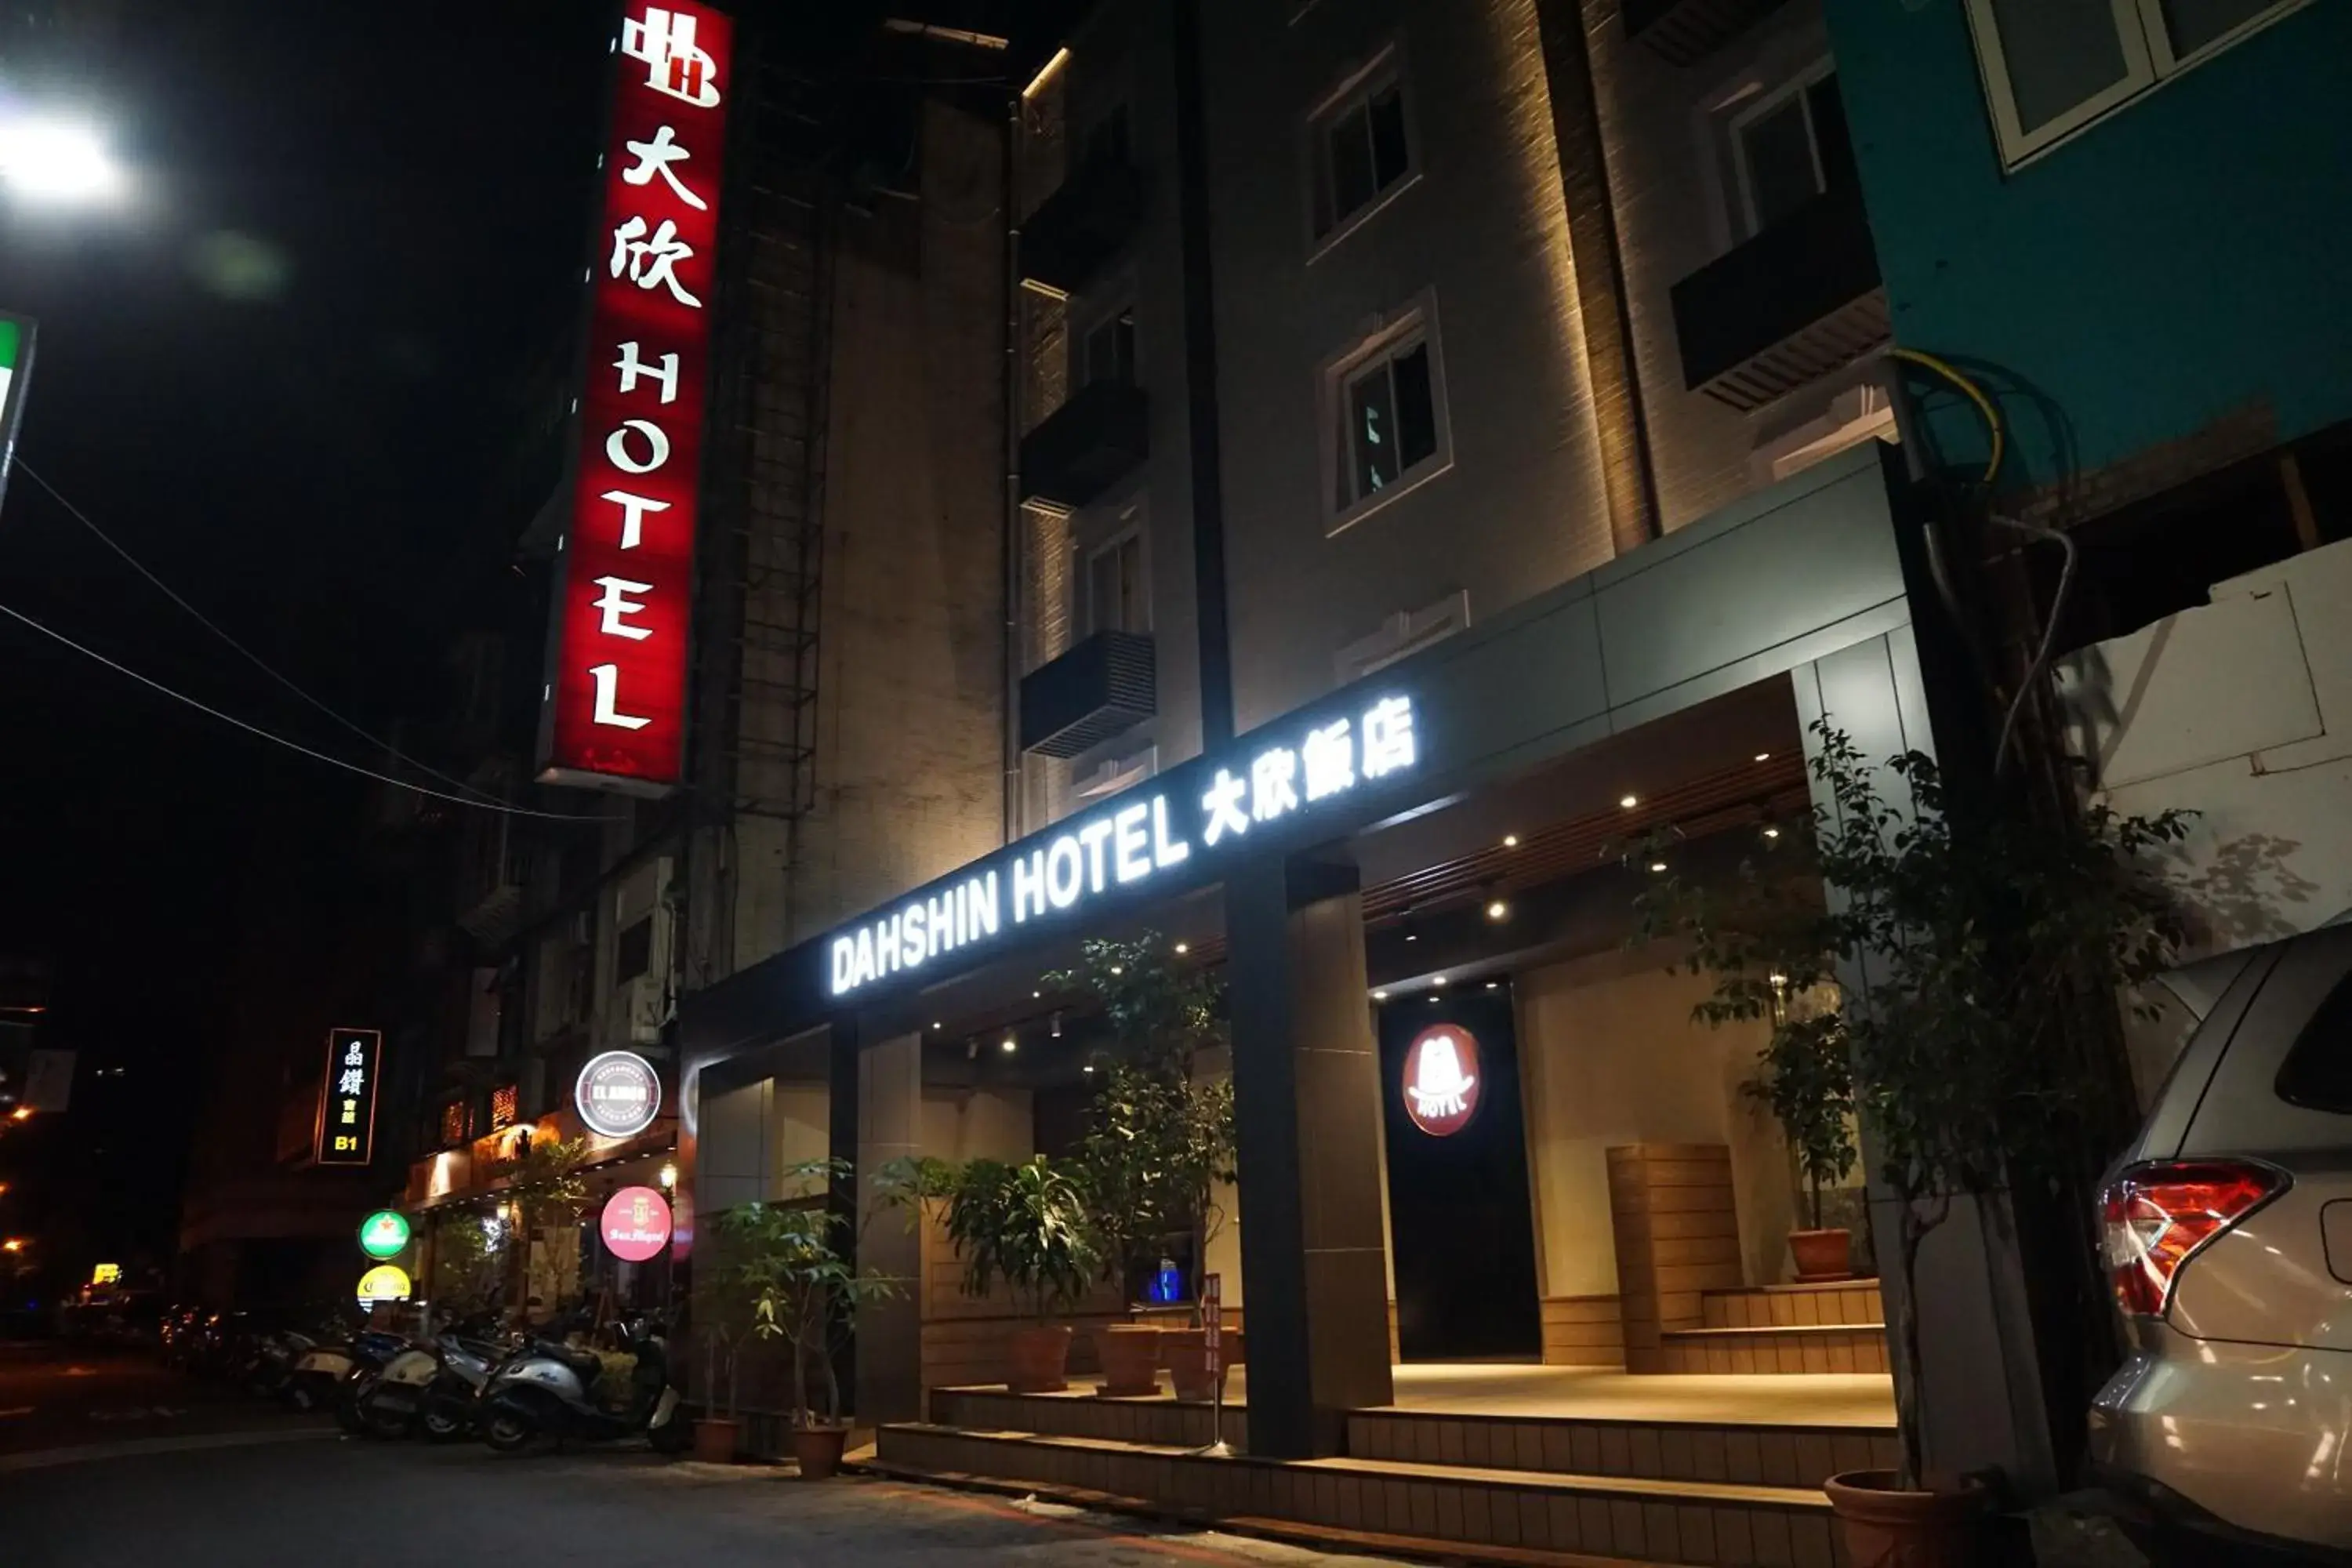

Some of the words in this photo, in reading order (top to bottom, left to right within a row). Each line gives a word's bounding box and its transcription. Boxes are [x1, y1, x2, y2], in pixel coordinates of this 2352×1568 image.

[610, 125, 708, 308] 大欣
[589, 341, 679, 730] HOTEL
[832, 869, 999, 996] DAHSHIN
[1014, 794, 1189, 923] HOTEL
[1201, 695, 1414, 847] 大欣飯店
[335, 1136, 358, 1151] B1
